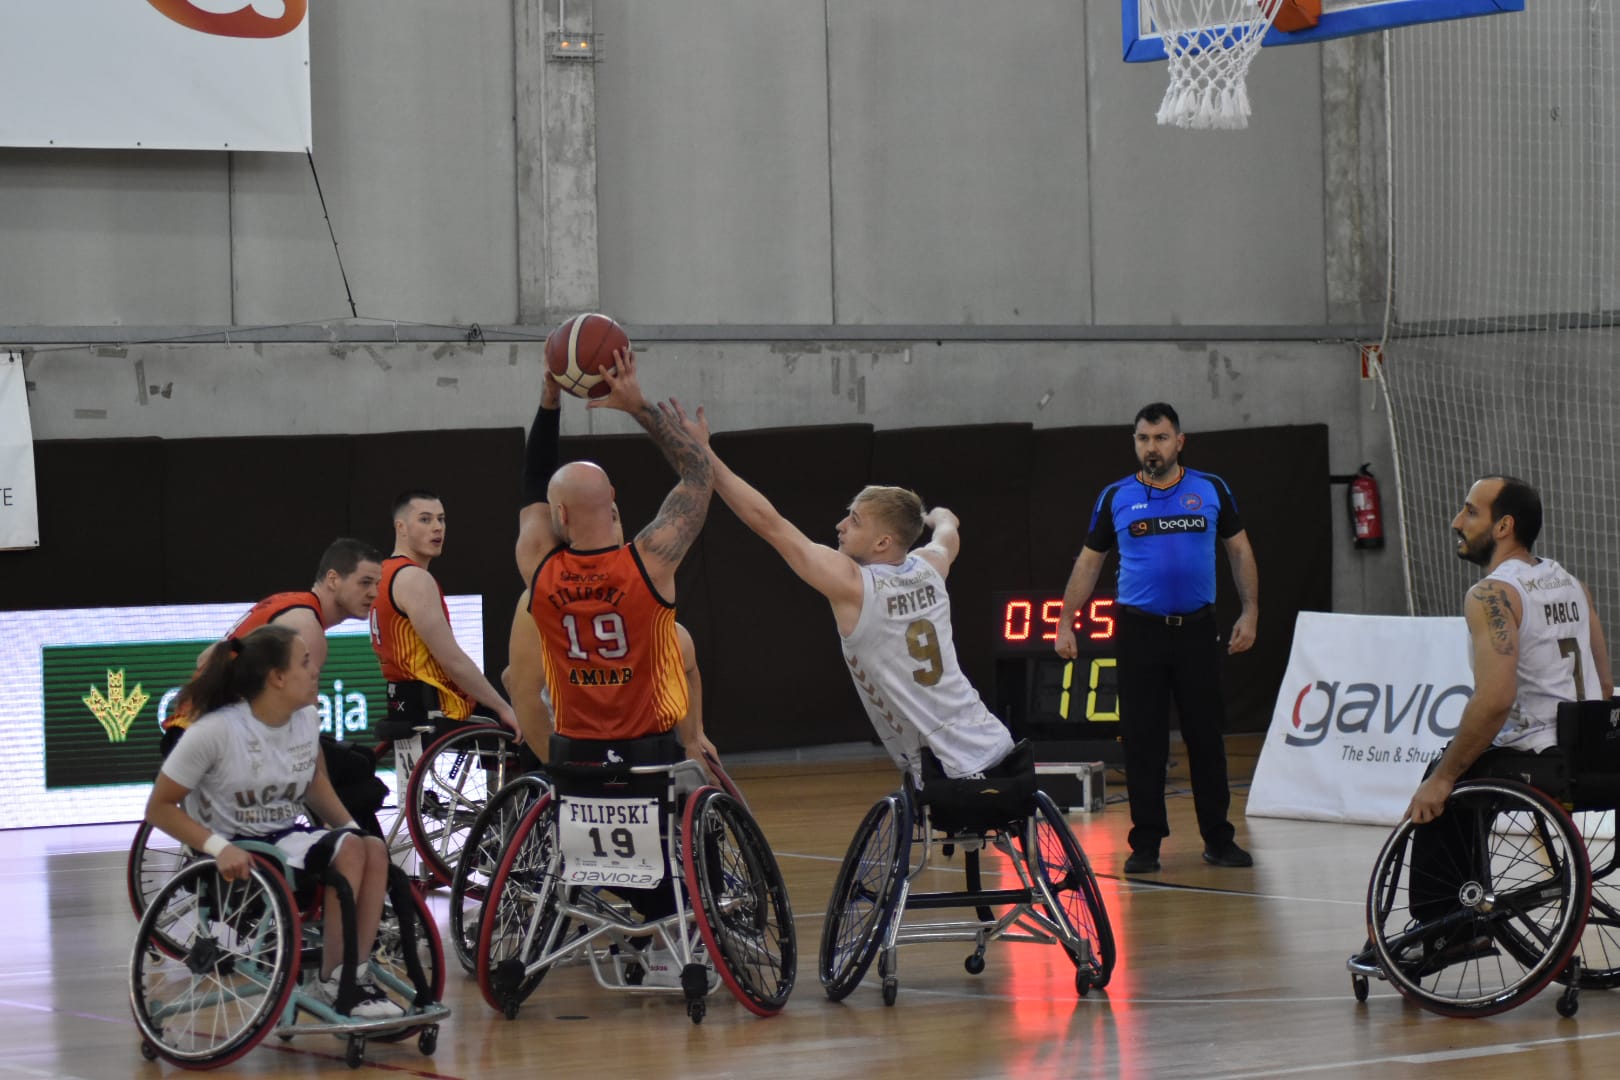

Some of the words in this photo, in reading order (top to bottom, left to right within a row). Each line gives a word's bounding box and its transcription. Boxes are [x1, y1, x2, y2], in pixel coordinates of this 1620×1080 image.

[1158, 515, 1205, 531] bequal
[548, 586, 626, 610] FILIPSKI
[886, 584, 937, 617] FRYER
[1543, 601, 1580, 625] PABLO
[561, 611, 630, 661] 19
[904, 618, 945, 688] 9
[569, 667, 633, 686] AMIAB
[1557, 637, 1587, 701] 7
[1284, 680, 1475, 747] gavio
[1341, 745, 1363, 761] The
[1366, 746, 1390, 762] Sun
[1393, 747, 1402, 763] &
[570, 803, 649, 825] FILIPSKI
[588, 827, 636, 858] 19
[571, 870, 653, 884] gaviota
